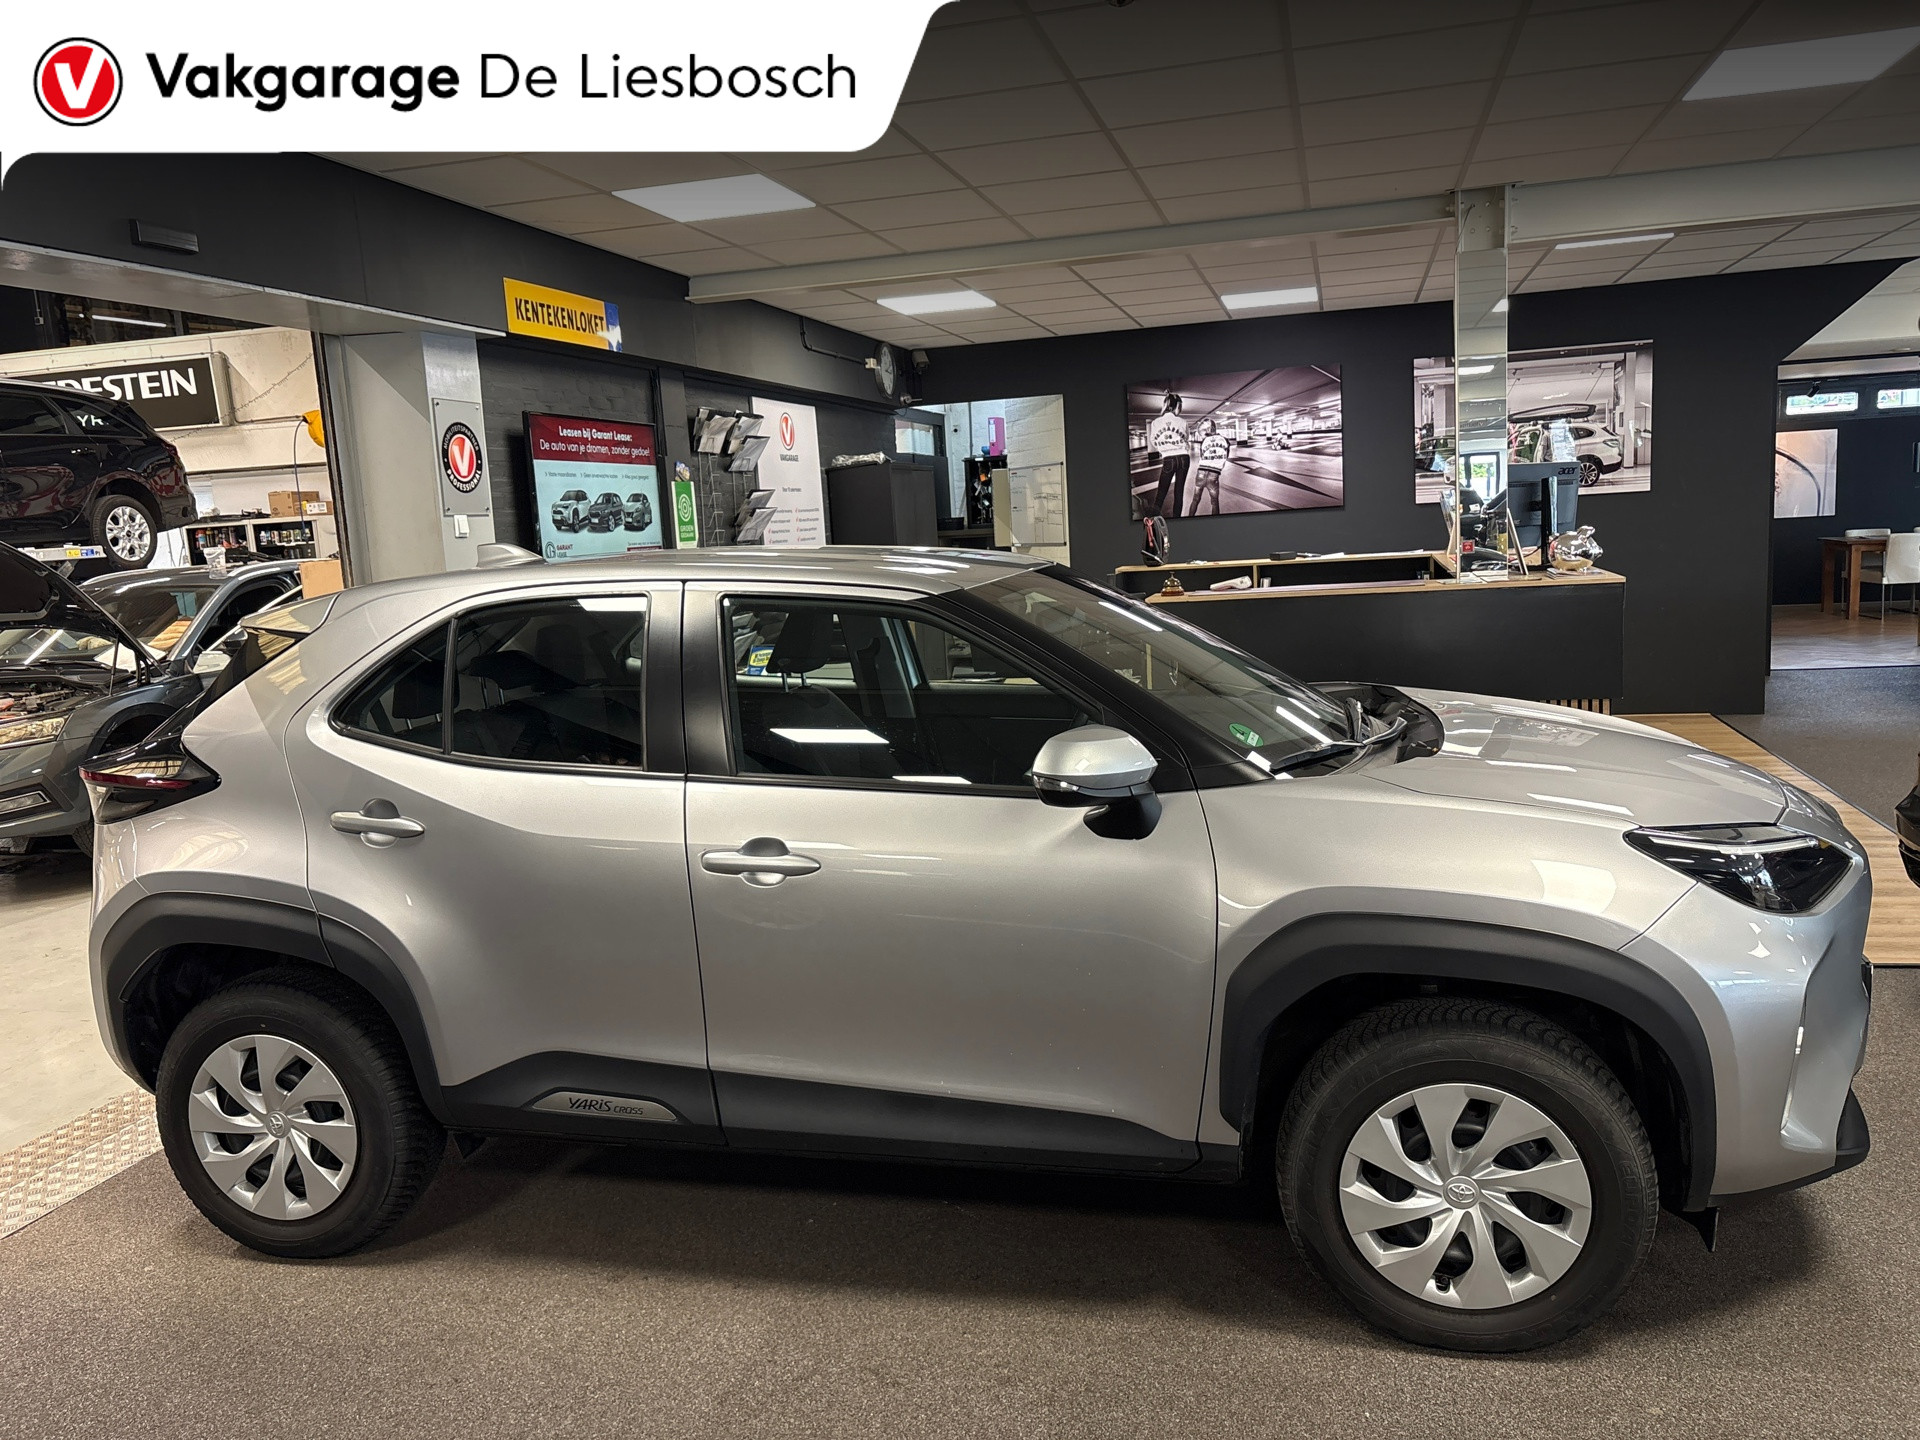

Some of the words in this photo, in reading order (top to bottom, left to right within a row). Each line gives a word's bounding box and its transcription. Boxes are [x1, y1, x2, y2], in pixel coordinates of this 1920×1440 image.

[514, 297, 605, 335] KENTEKENLOKET
[443, 424, 480, 452] MOBILITEITSPARTNER
[558, 425, 582, 438] Leasen
[582, 428, 591, 441] bij
[591, 428, 613, 441] Garant
[613, 430, 633, 442] Lease:
[539, 439, 550, 450] De
[550, 441, 566, 451] auto
[566, 443, 579, 452] van
[578, 443, 586, 455] je
[585, 443, 611, 455] dromen,
[611, 445, 631, 455] zonder
[1558, 467, 1577, 475] acer
[446, 469, 482, 491] PROFESSIONAL
[614, 1105, 644, 1115] CROSS
